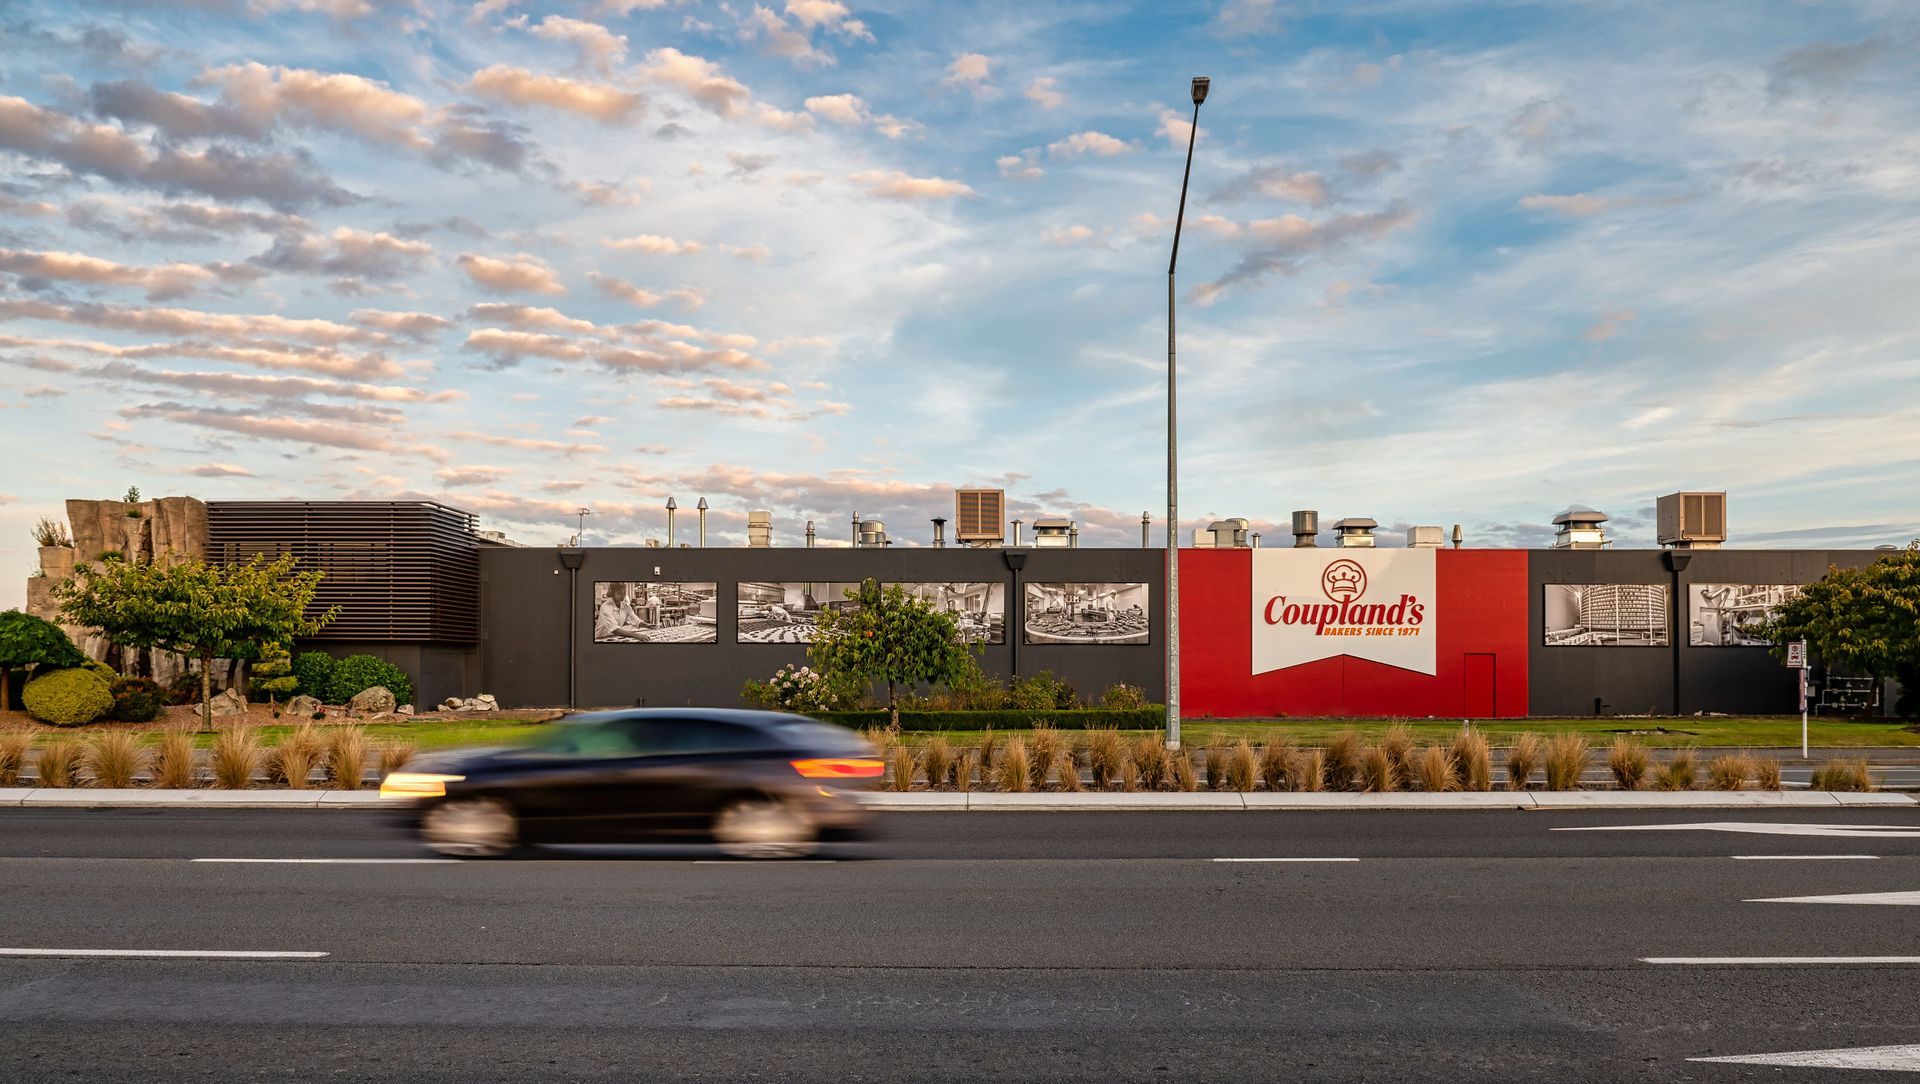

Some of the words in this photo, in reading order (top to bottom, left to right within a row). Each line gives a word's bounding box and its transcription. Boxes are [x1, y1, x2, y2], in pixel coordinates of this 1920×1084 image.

[1264, 594, 1425, 635] Coupland's
[1324, 627, 1362, 636] BAKERS
[1366, 627, 1394, 636] SINCE
[1397, 627, 1420, 636] 1971
